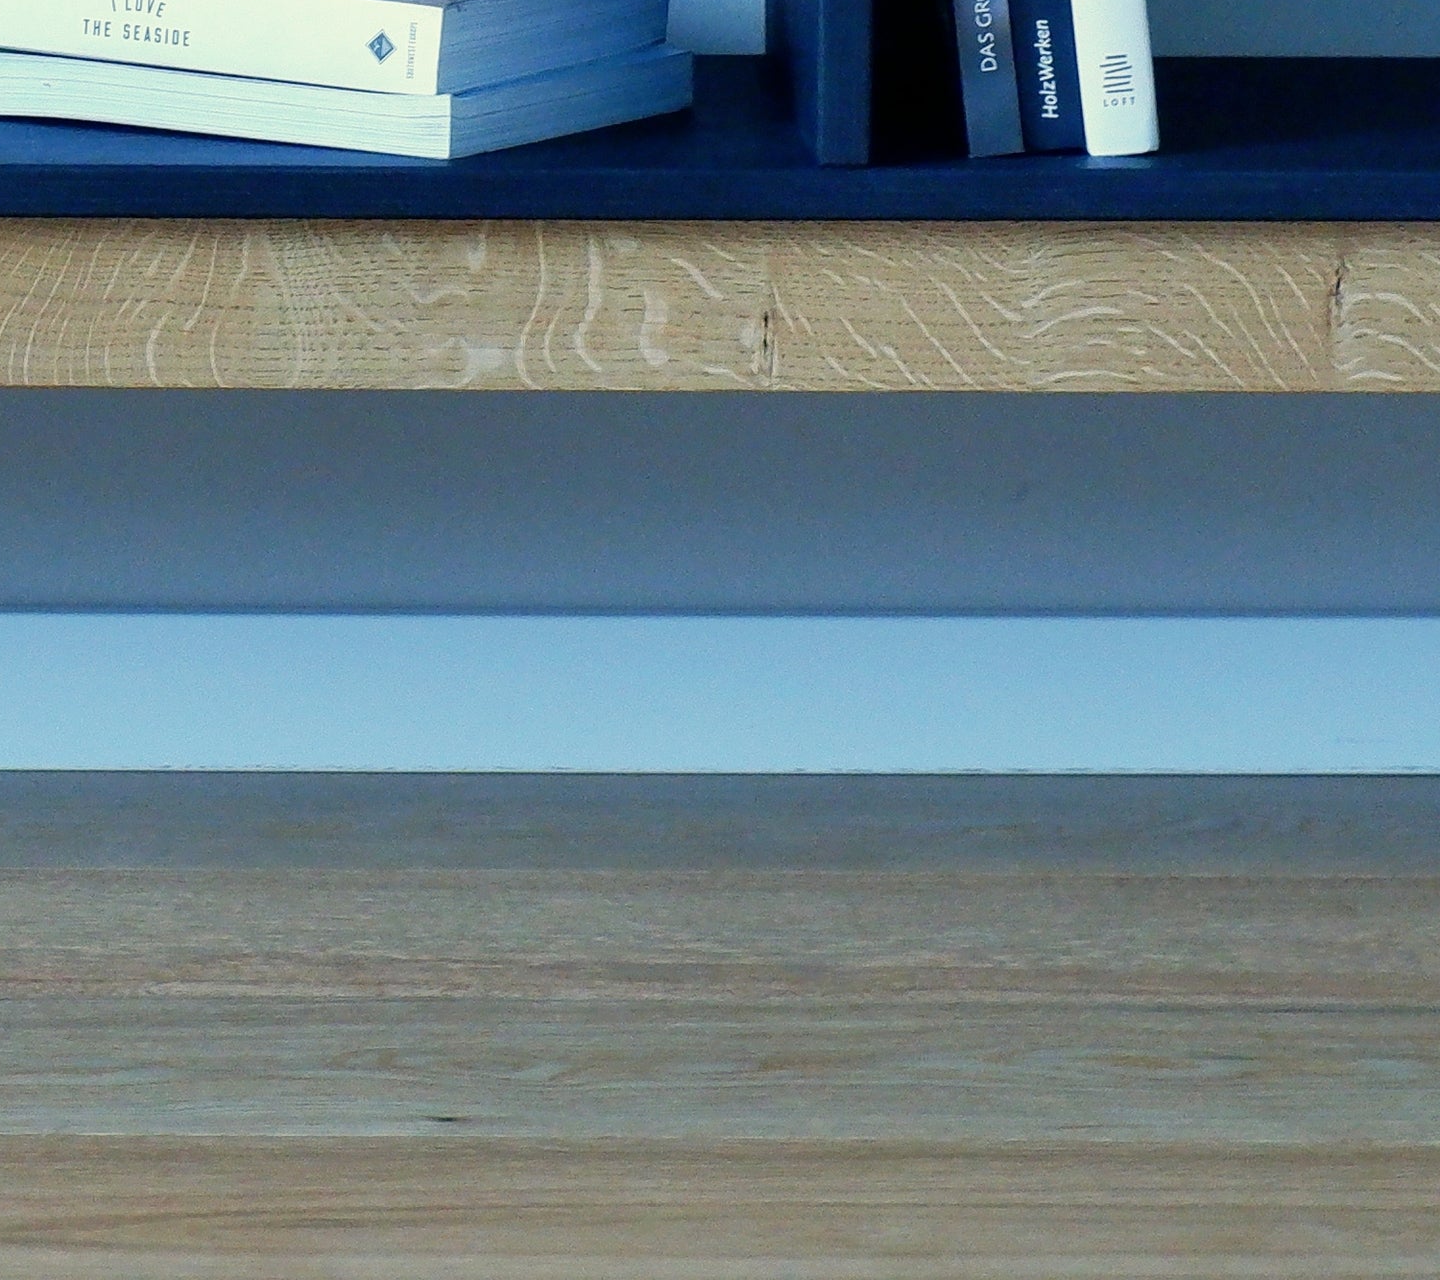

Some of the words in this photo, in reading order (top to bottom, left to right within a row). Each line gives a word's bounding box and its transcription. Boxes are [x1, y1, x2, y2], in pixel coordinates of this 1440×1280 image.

[83, 18, 112, 38] THE
[122, 23, 191, 48] SEASIDE
[976, 32, 999, 73] DAS
[1033, 18, 1060, 119] HolzWerken
[1103, 96, 1135, 107] LOFT
